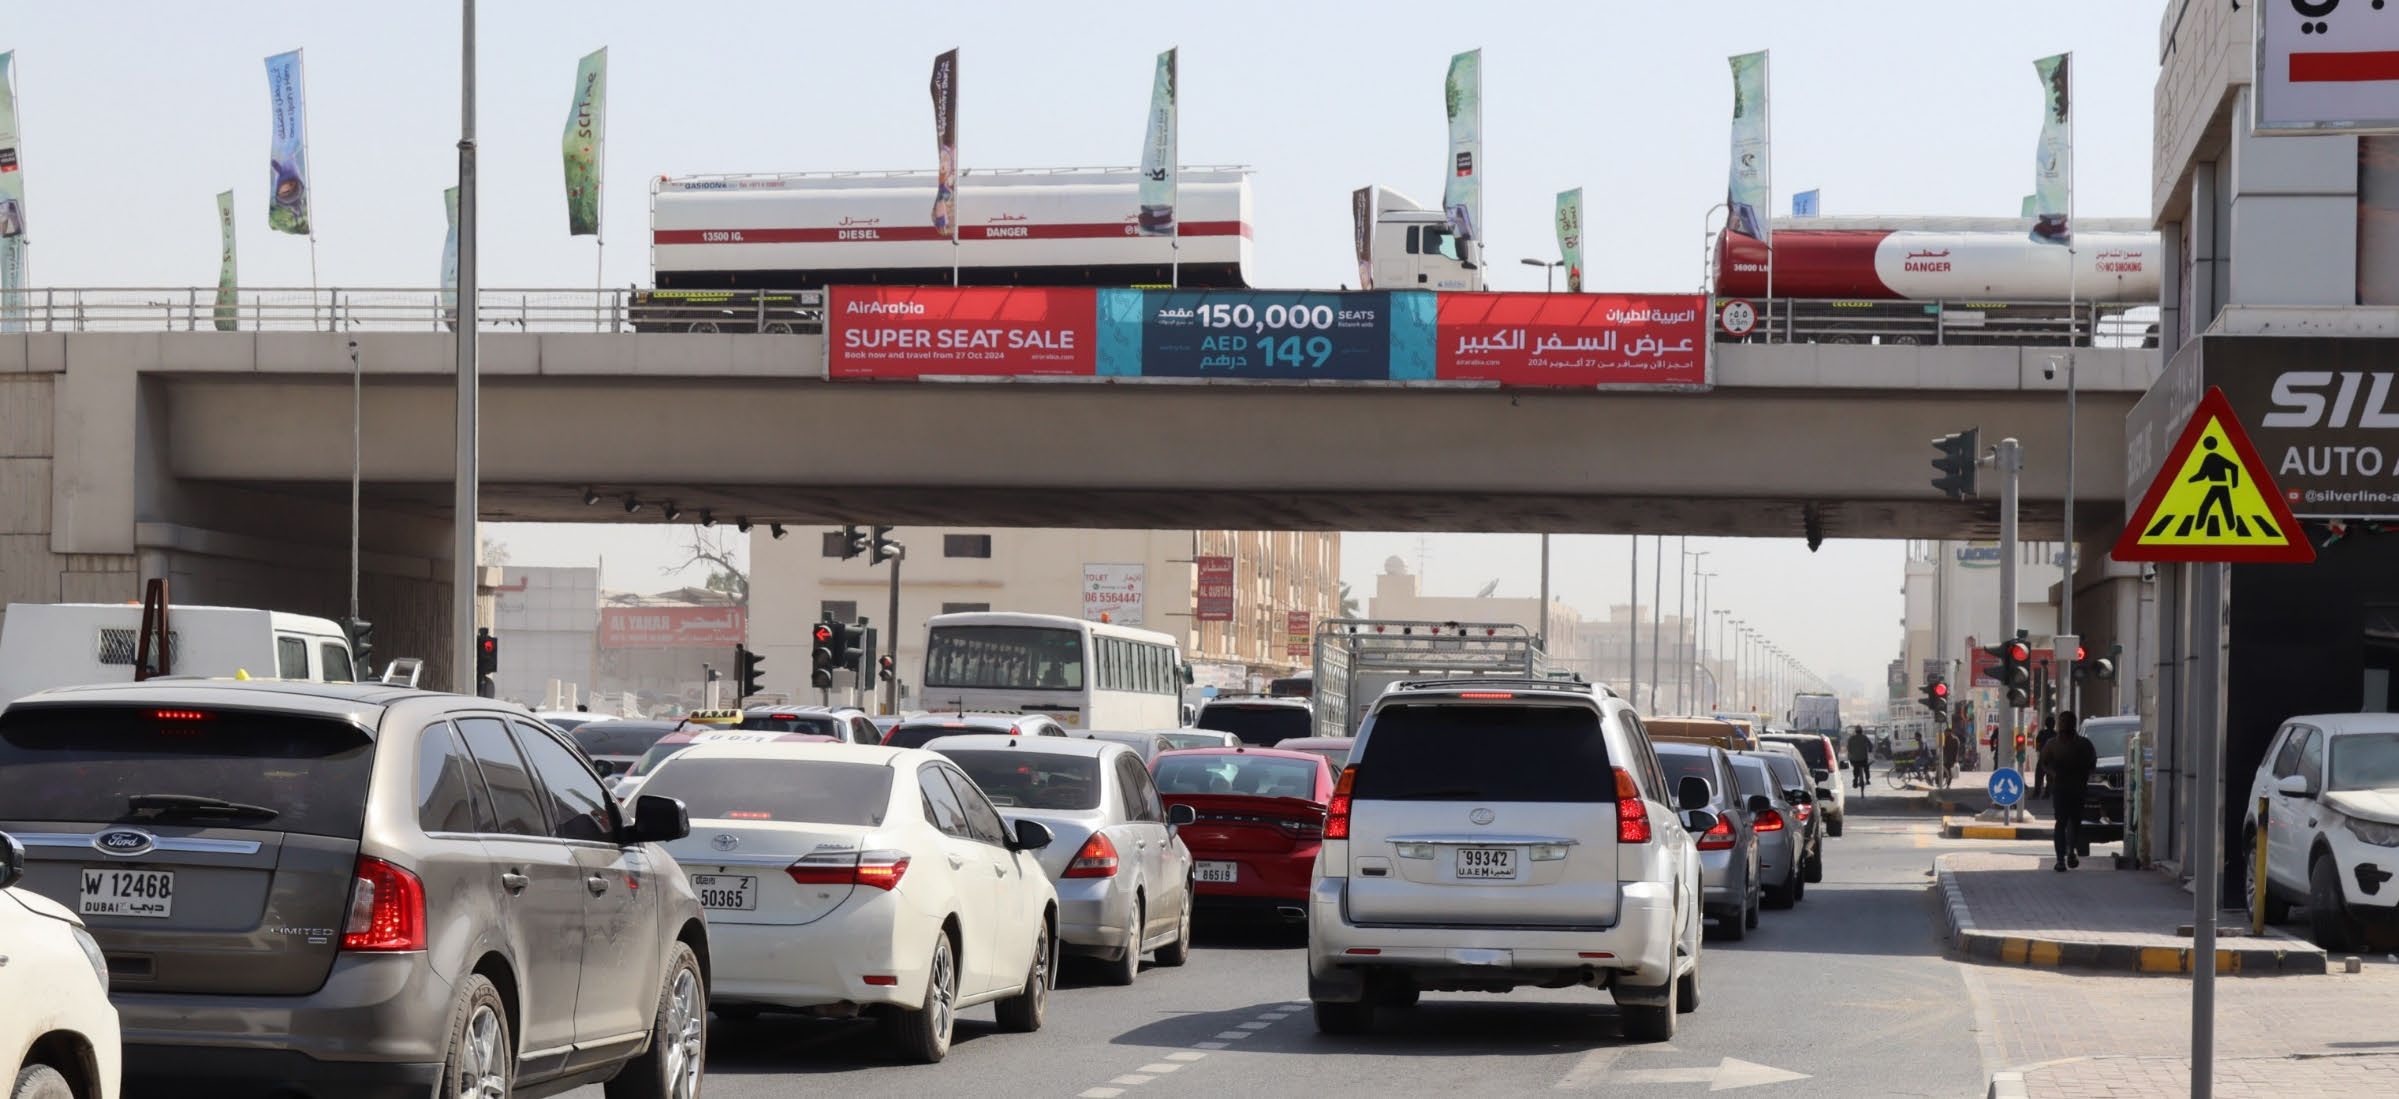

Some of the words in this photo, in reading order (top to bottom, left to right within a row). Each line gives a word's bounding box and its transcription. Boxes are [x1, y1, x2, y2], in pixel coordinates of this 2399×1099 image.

[988, 212, 1028, 223] خطر
[702, 231, 729, 242] 13500
[838, 229, 880, 240] DIESEL
[986, 226, 1028, 238] DANGER
[1905, 249, 1951, 259] خطر
[1734, 263, 1757, 272] 36000
[1904, 262, 1951, 273] DANGER
[2115, 262, 2142, 272] SMOKING
[846, 300, 925, 315] AirArabia
[1158, 307, 1194, 318] مقعد
[1197, 304, 1334, 335] 150,000
[1338, 310, 1375, 320] SEATS
[1606, 308, 1651, 324] للطيران
[1651, 310, 1695, 324] العربية
[845, 329, 931, 349] SUPER
[937, 329, 1003, 349] SEAT
[1008, 330, 1074, 349] SALE
[1200, 335, 1248, 351] AED
[1455, 329, 1525, 355] الكبير
[1531, 331, 1617, 355] السفر
[1624, 333, 1693, 357] عرض
[845, 351, 866, 359] Book
[888, 351, 905, 359] and
[906, 351, 931, 359] travel
[933, 351, 954, 359] from
[1256, 335, 1333, 368] 149
[1200, 353, 1248, 370] درهم
[1528, 359, 1548, 367] 2024
[1585, 359, 1596, 367] 27
[2279, 446, 2383, 477] AUTO
[1085, 591, 1097, 602] 06
[1099, 592, 1142, 603] 5564447
[698, 710, 737, 719] TAXI
[107, 833, 137, 847] Ford
[1466, 850, 1508, 866] 99342
[85, 872, 103, 895] W
[112, 873, 170, 899] 12468
[740, 878, 749, 890] Z
[701, 889, 743, 908] 50365
[85, 901, 119, 912] DUBAI
[129, 903, 165, 914] دبي
[270, 927, 334, 936] LIMITED
